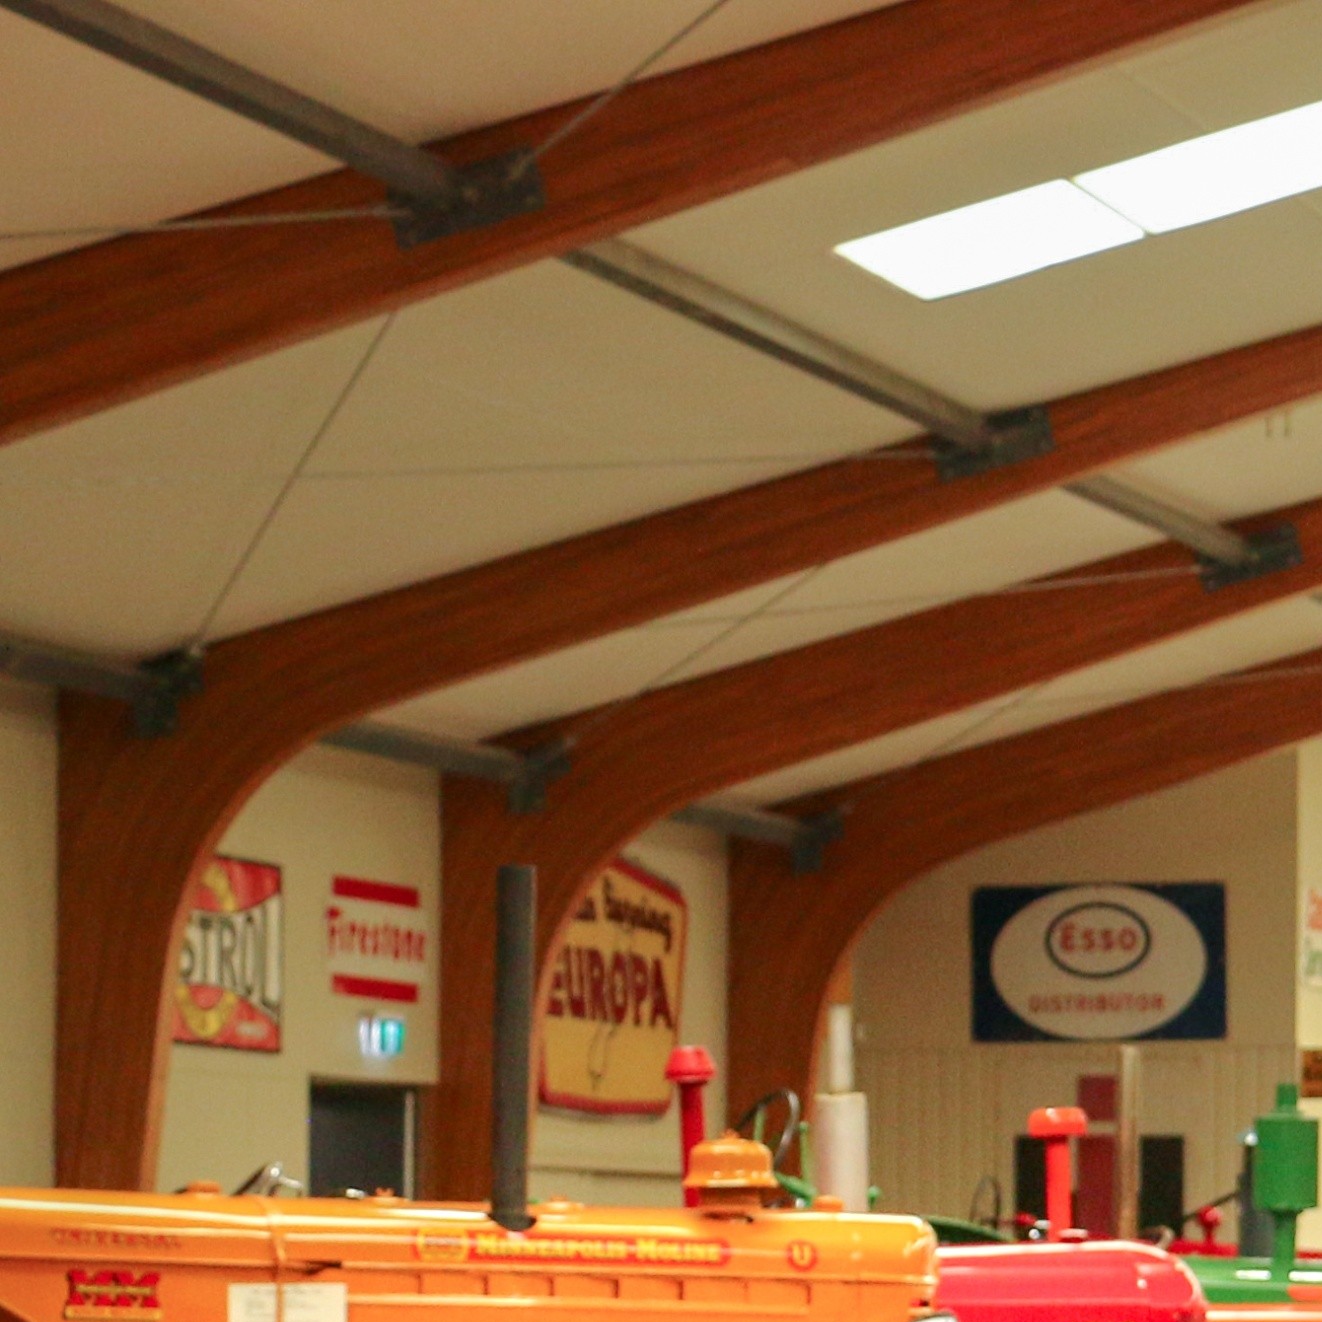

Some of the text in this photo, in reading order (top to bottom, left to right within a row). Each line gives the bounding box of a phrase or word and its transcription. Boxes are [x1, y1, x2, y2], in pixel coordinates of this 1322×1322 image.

[326, 907, 425, 962] Firestone
[1059, 922, 1138, 953] Esso
[1028, 993, 1166, 1014] DISTRIBUTOR
